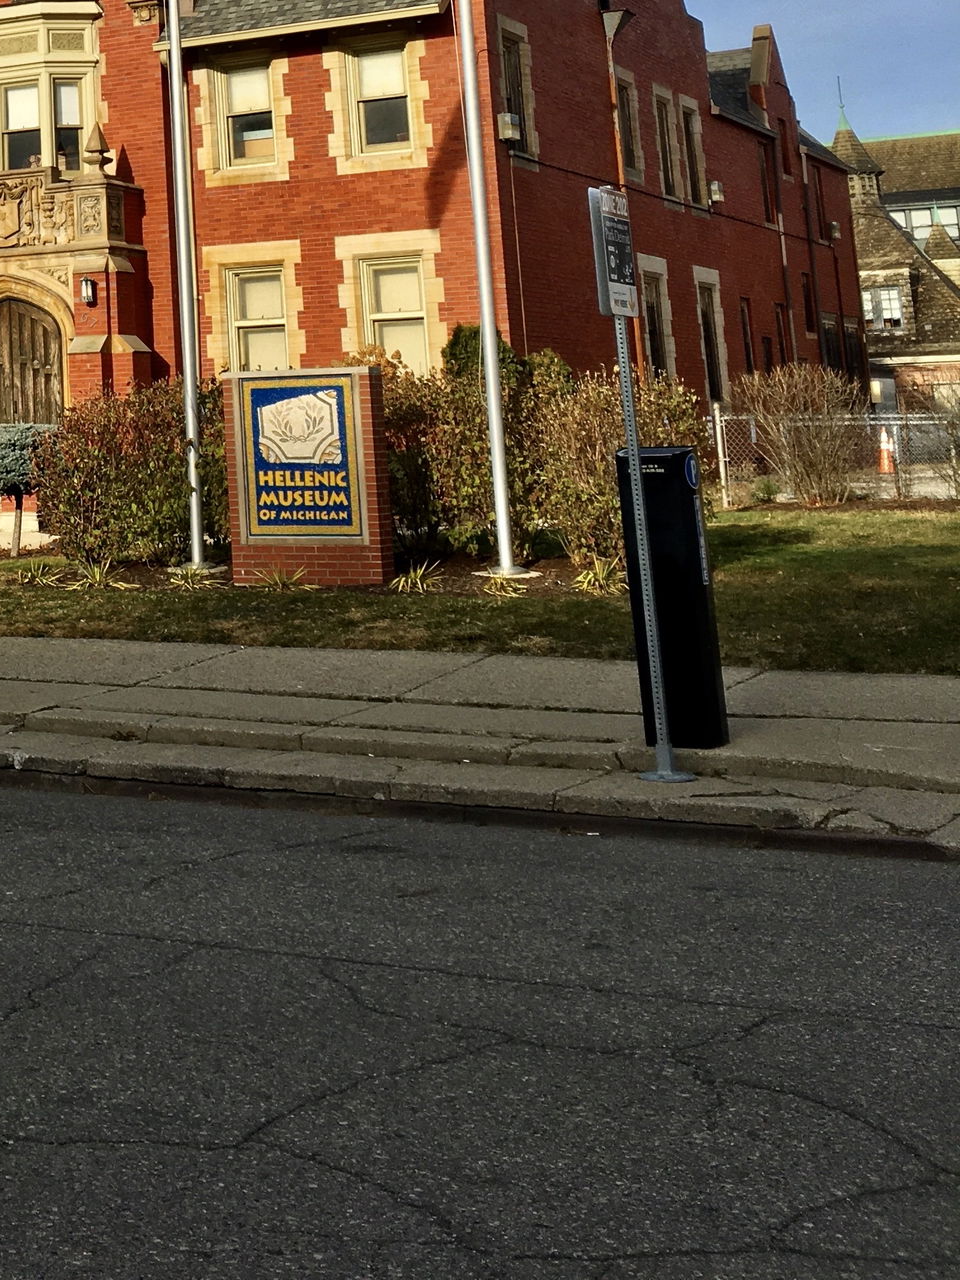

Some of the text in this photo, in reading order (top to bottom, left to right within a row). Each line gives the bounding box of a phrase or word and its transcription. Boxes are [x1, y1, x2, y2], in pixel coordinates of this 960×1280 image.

[259, 471, 347, 487] HELLENIC
[259, 491, 349, 506] MUSEUM
[259, 509, 348, 520] OF MICHIGAN
